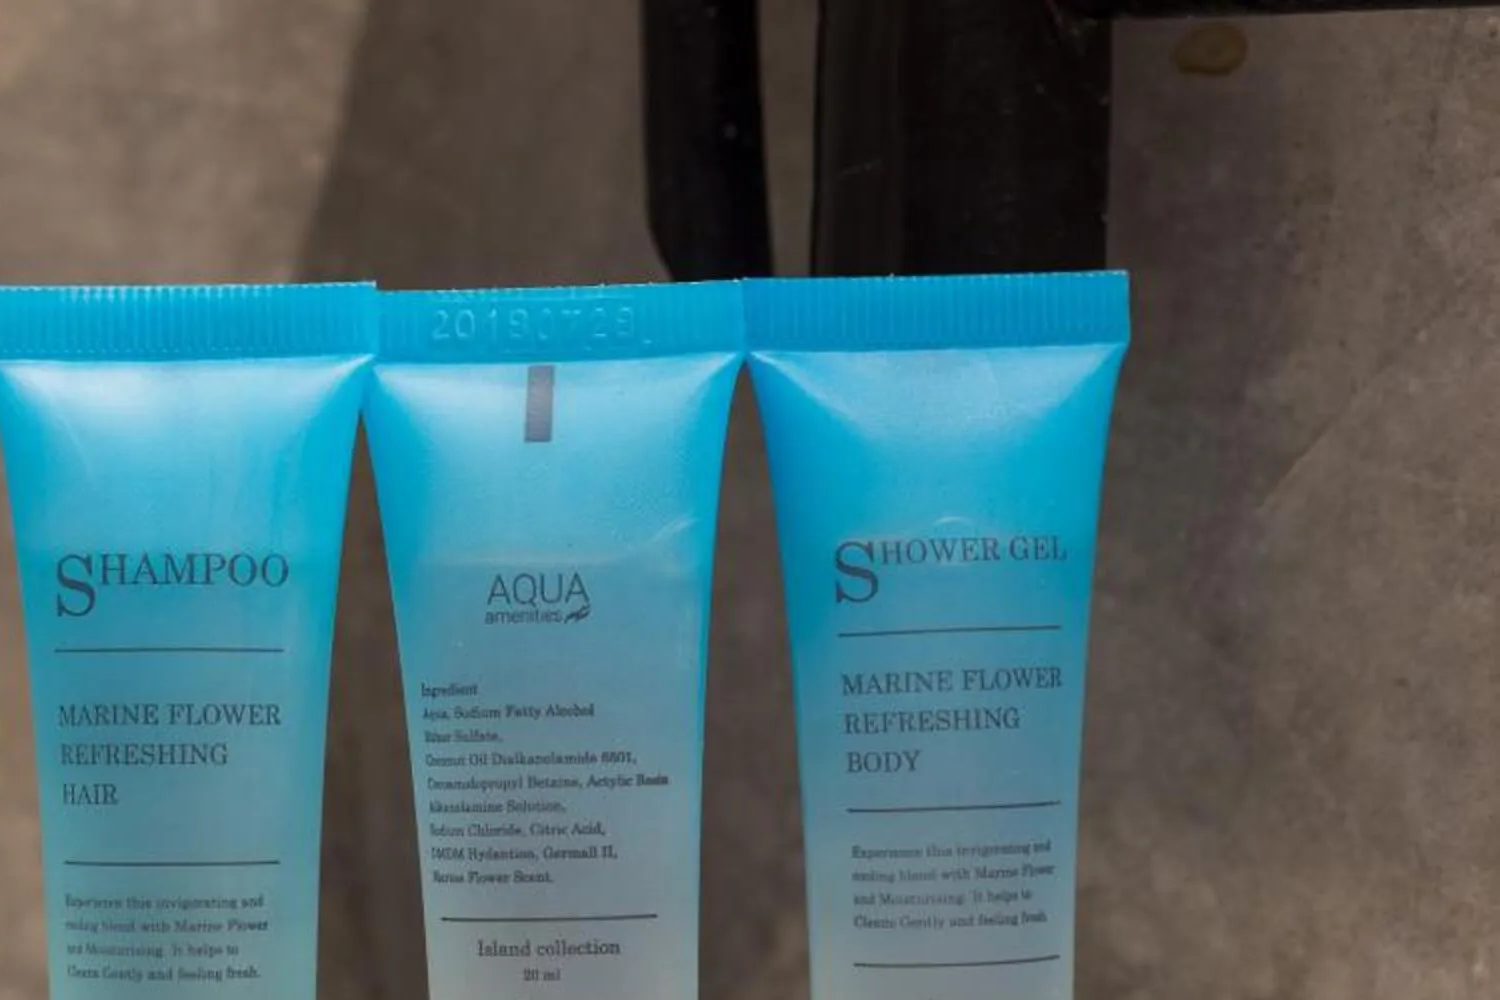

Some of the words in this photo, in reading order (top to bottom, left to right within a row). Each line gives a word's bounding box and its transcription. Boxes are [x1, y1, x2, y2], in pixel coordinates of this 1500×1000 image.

[834, 537, 1001, 604] SHOWER
[1008, 535, 1068, 562] GEL
[55, 552, 290, 618] SHAMPOO
[486, 571, 590, 607] AQUA
[483, 607, 564, 625] amenities
[421, 682, 478, 699] Ingredient
[841, 670, 953, 697] MARINE
[961, 666, 1064, 692] FLOWER
[58, 704, 160, 727] MARINE
[169, 703, 282, 727] FLOWER
[505, 703, 541, 721] Fatty
[844, 706, 1020, 735] REFRESHING
[60, 742, 229, 766] REFRESHING
[845, 750, 921, 774] BODY
[61, 782, 120, 806] HAIR
[477, 938, 532, 958] Island
[536, 938, 622, 958] collection
